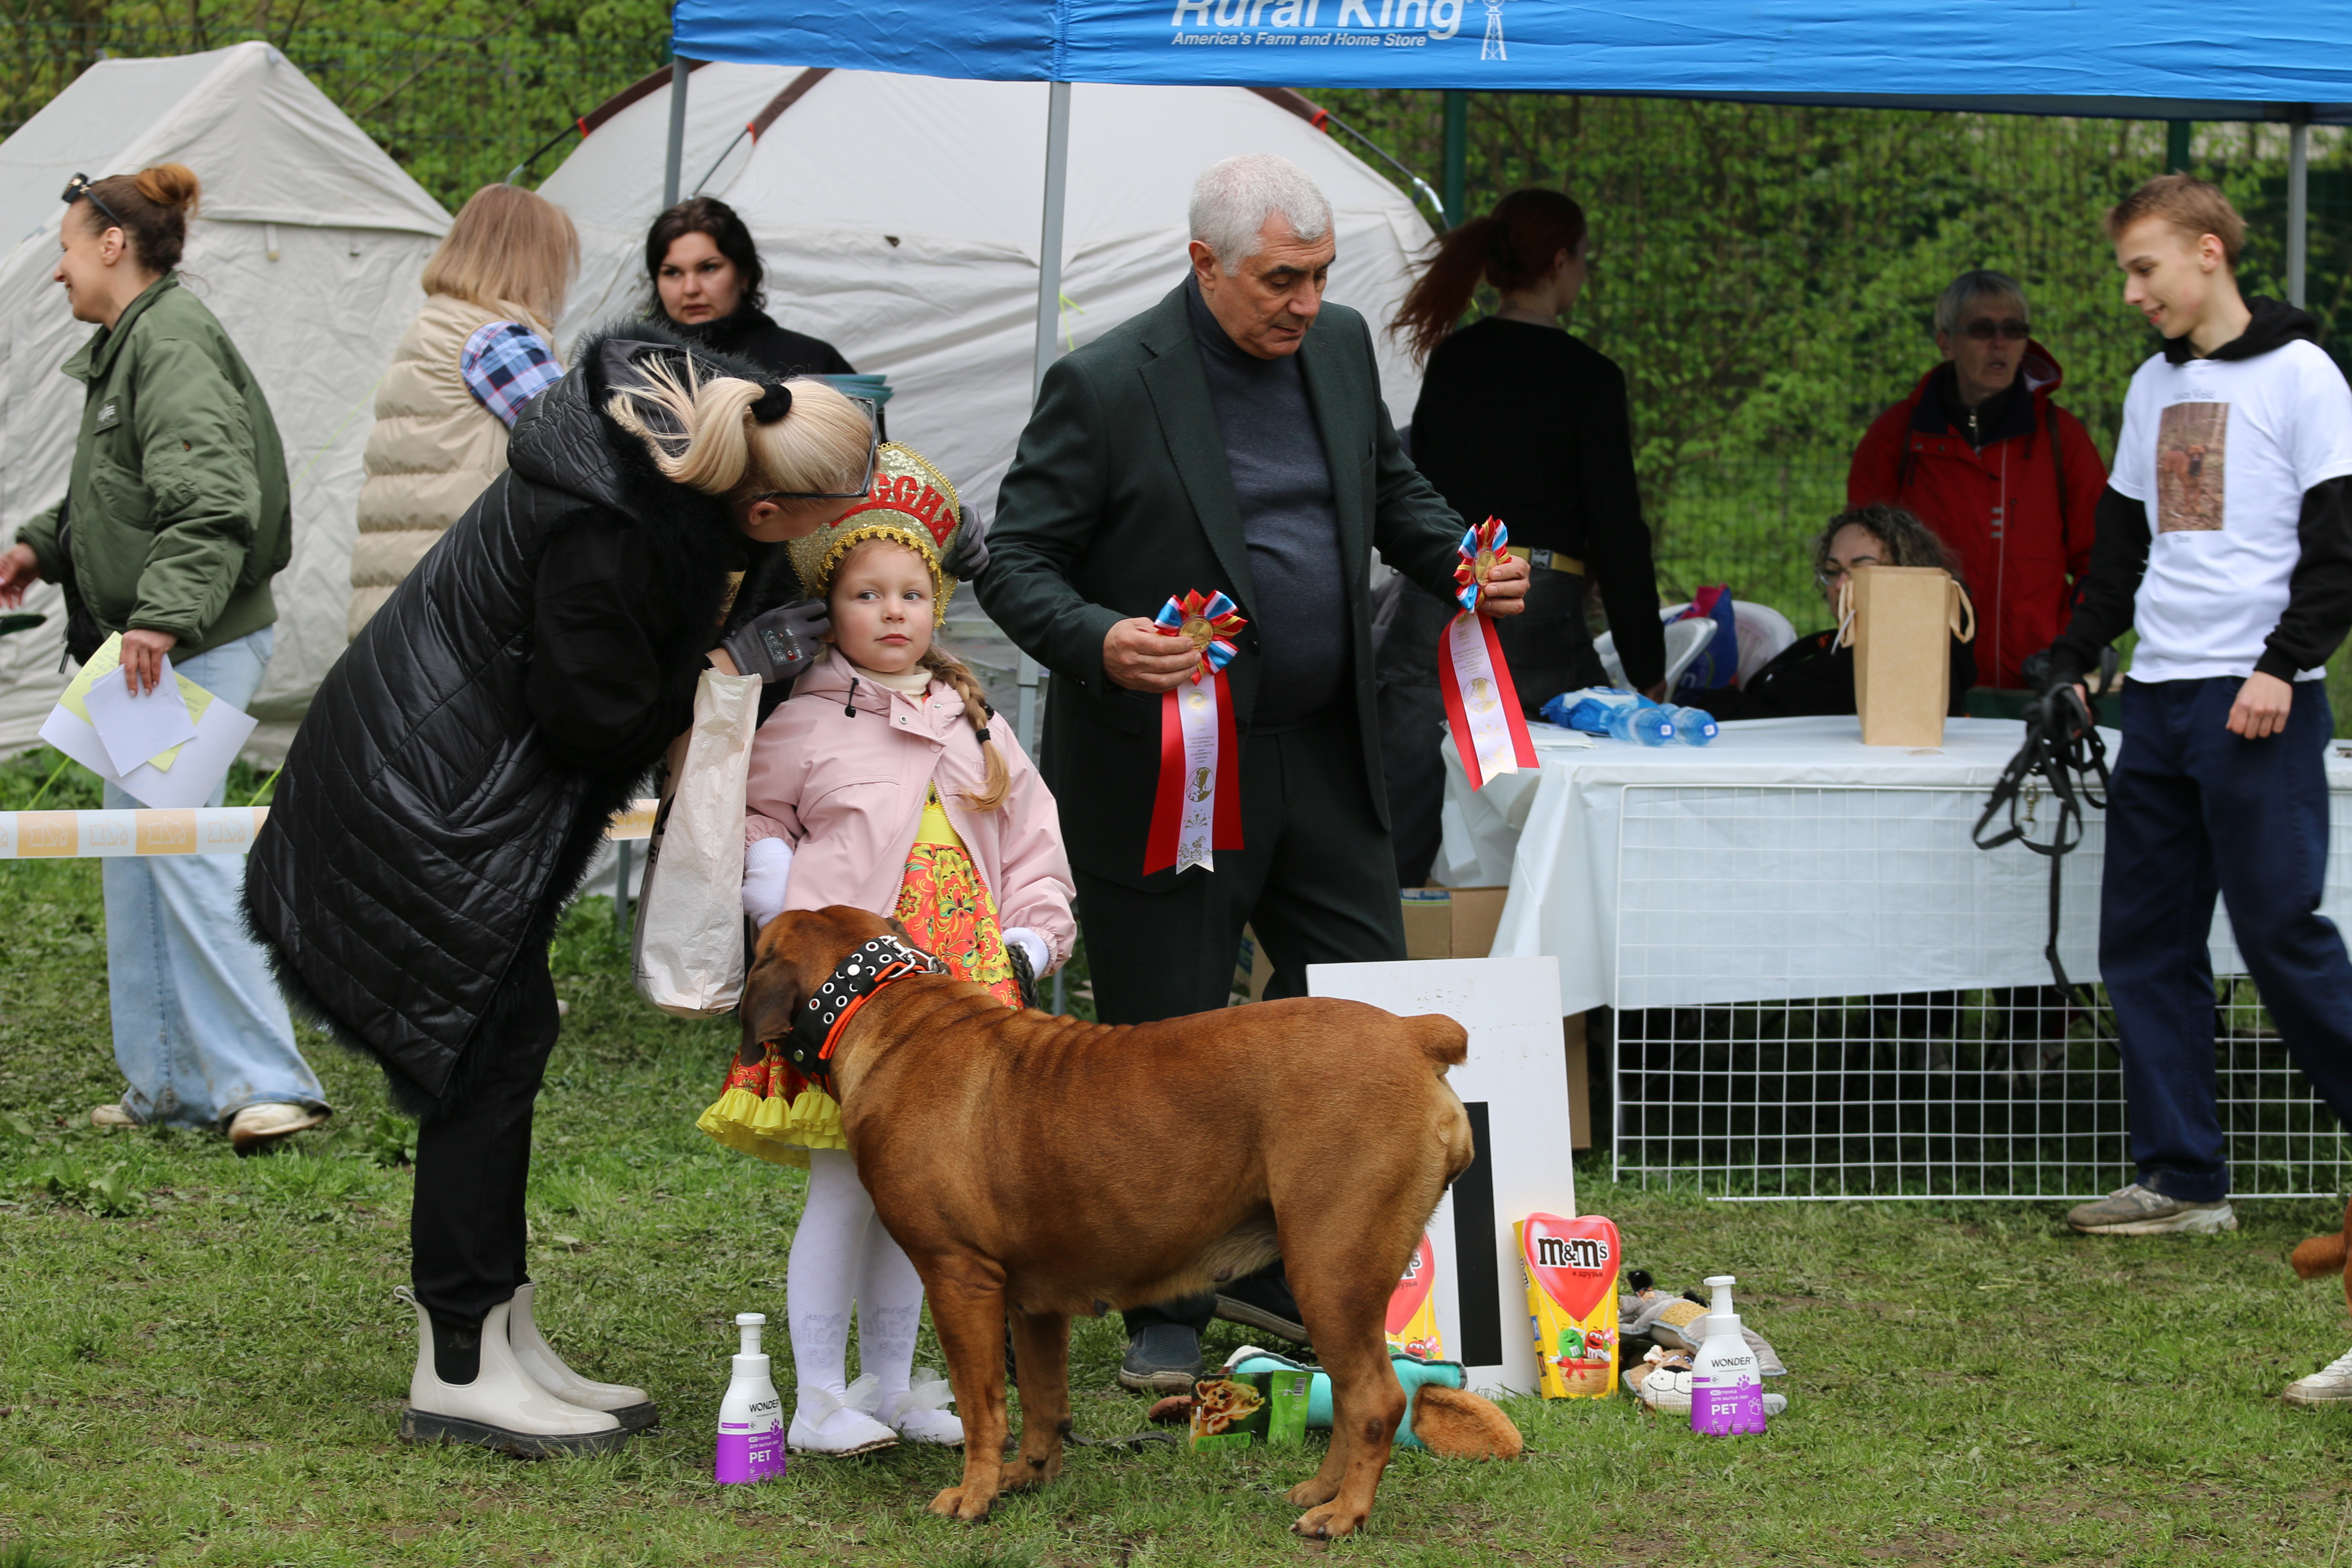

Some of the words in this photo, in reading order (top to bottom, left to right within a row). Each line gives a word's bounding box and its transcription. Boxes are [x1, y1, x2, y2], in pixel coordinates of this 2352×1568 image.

[1171, 0, 1319, 27] Rural
[1337, 0, 1464, 40] King
[1172, 32, 1252, 45] America's
[1255, 32, 1297, 45] Farm
[1299, 33, 1332, 46] and
[1334, 33, 1380, 46] Home
[1384, 33, 1426, 47] Store
[867, 473, 957, 548] ССИЯ
[1578, 1271, 1603, 1279] друзья
[1711, 1357, 1751, 1368] WONDER
[1711, 1403, 1738, 1416] PET
[749, 1449, 772, 1464] PET
